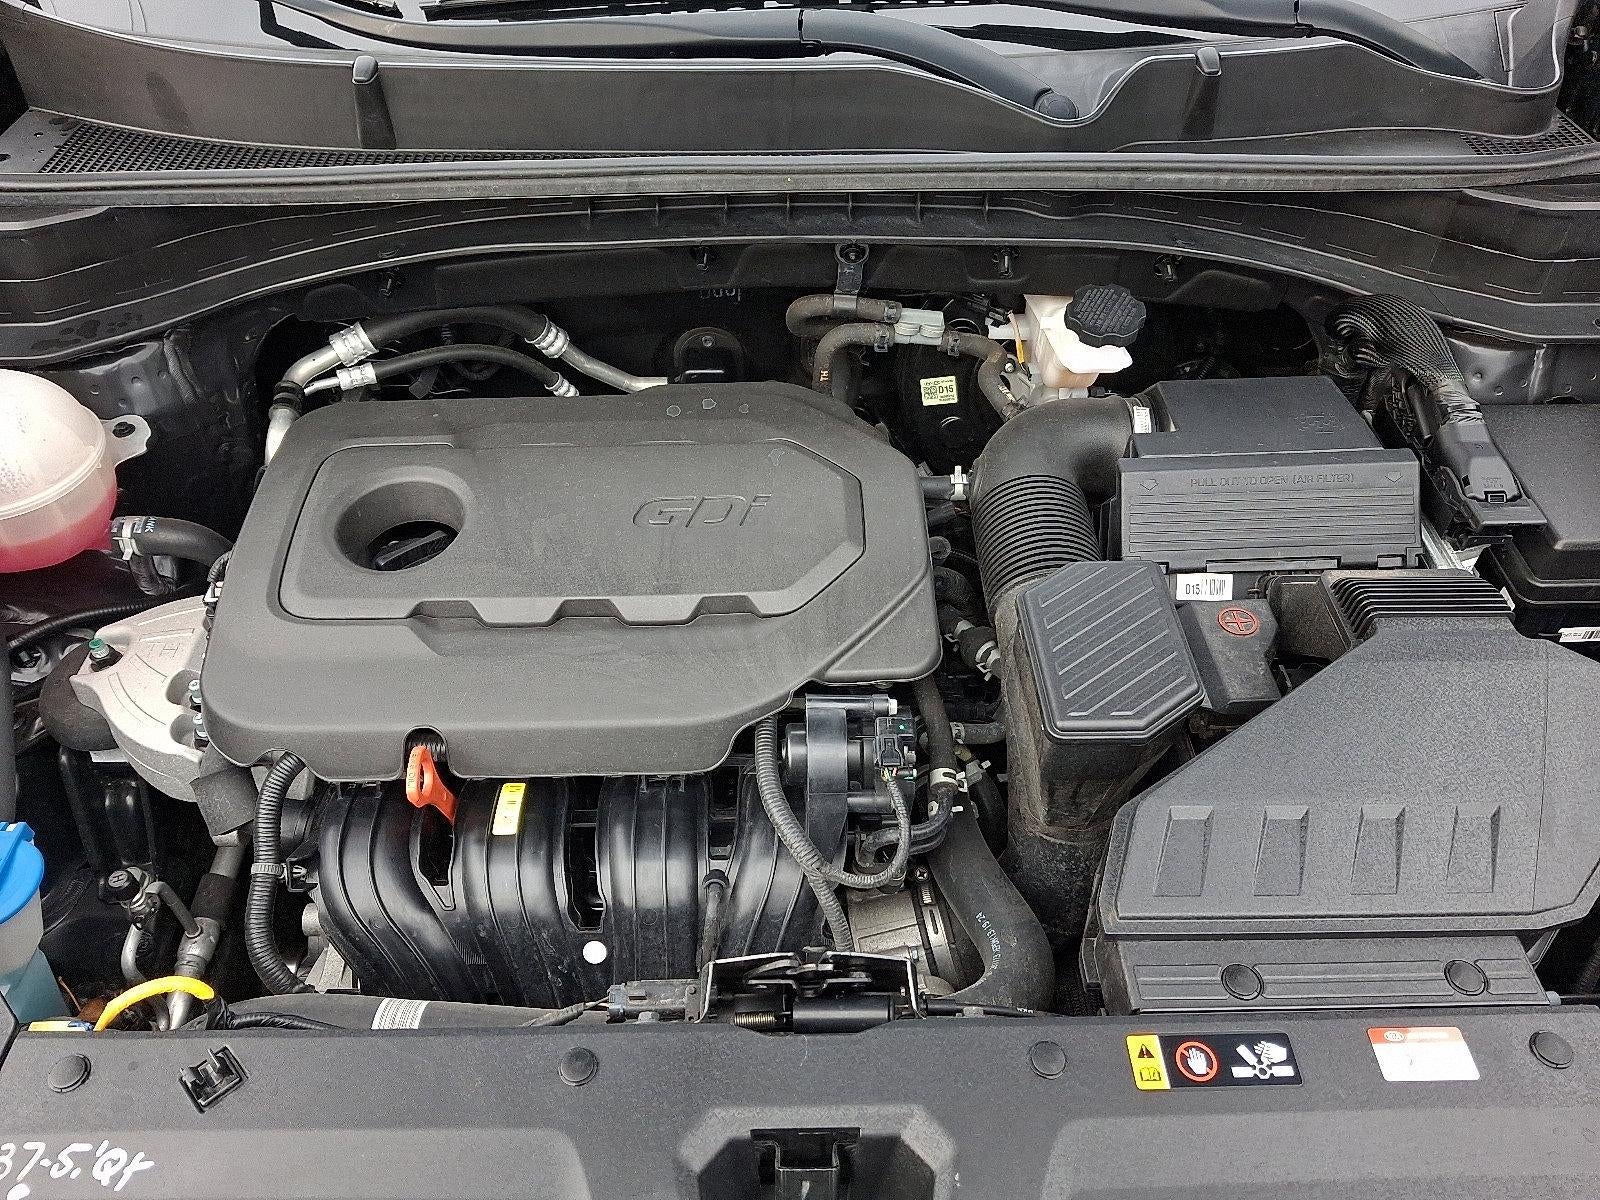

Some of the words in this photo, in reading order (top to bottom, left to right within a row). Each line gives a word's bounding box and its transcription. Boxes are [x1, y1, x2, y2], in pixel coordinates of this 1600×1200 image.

[938, 384, 954, 394] D15
[1190, 477, 1218, 487] PULL
[1259, 475, 1288, 486] OPEN
